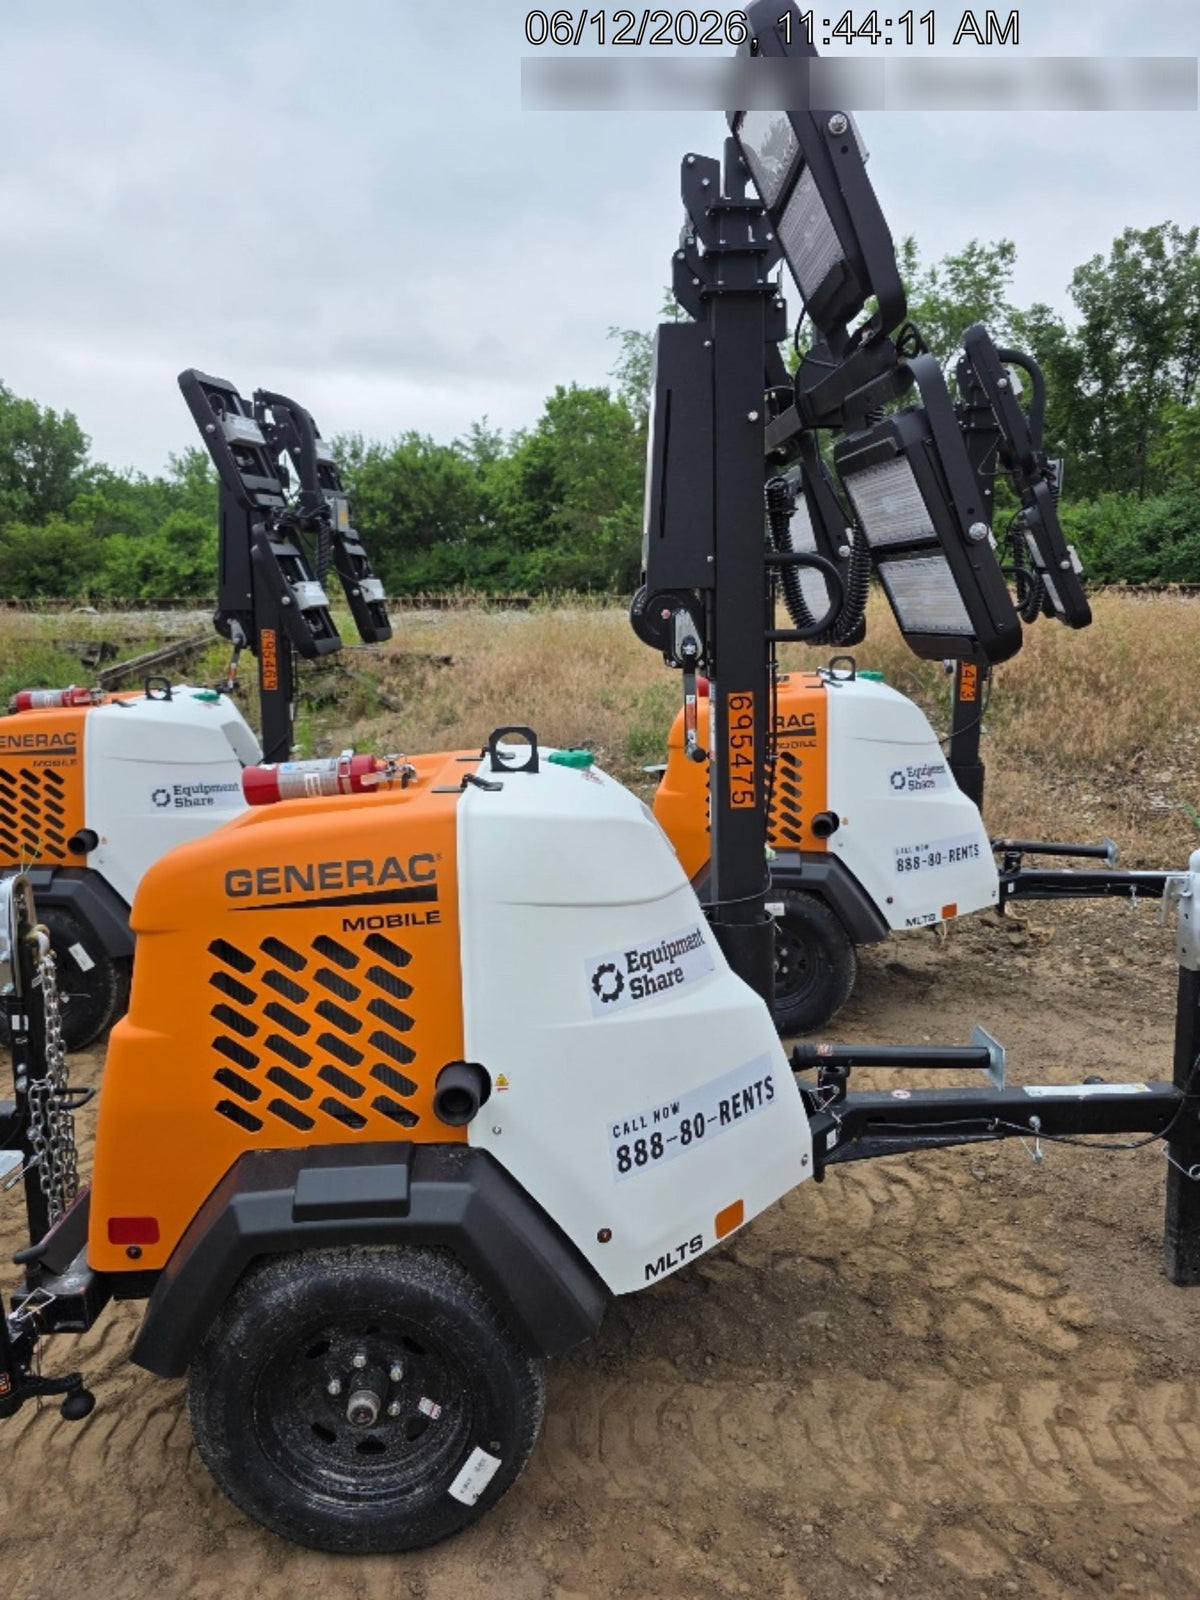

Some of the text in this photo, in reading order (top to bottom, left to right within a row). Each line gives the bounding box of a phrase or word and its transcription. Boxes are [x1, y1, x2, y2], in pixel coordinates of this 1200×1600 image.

[729, 696, 754, 804] 695475
[173, 783, 239, 796] Equipment
[175, 797, 214, 808] Share
[224, 853, 437, 897] GENERAC
[896, 844, 979, 872] 888-80-RENTS
[342, 910, 441, 932] MOBILE
[624, 927, 705, 974] Equipment
[629, 967, 684, 999] Share
[612, 1102, 680, 1138] CALL NOW
[616, 1075, 775, 1173] 888-80-RENTS
[645, 1234, 703, 1280] MLTS
